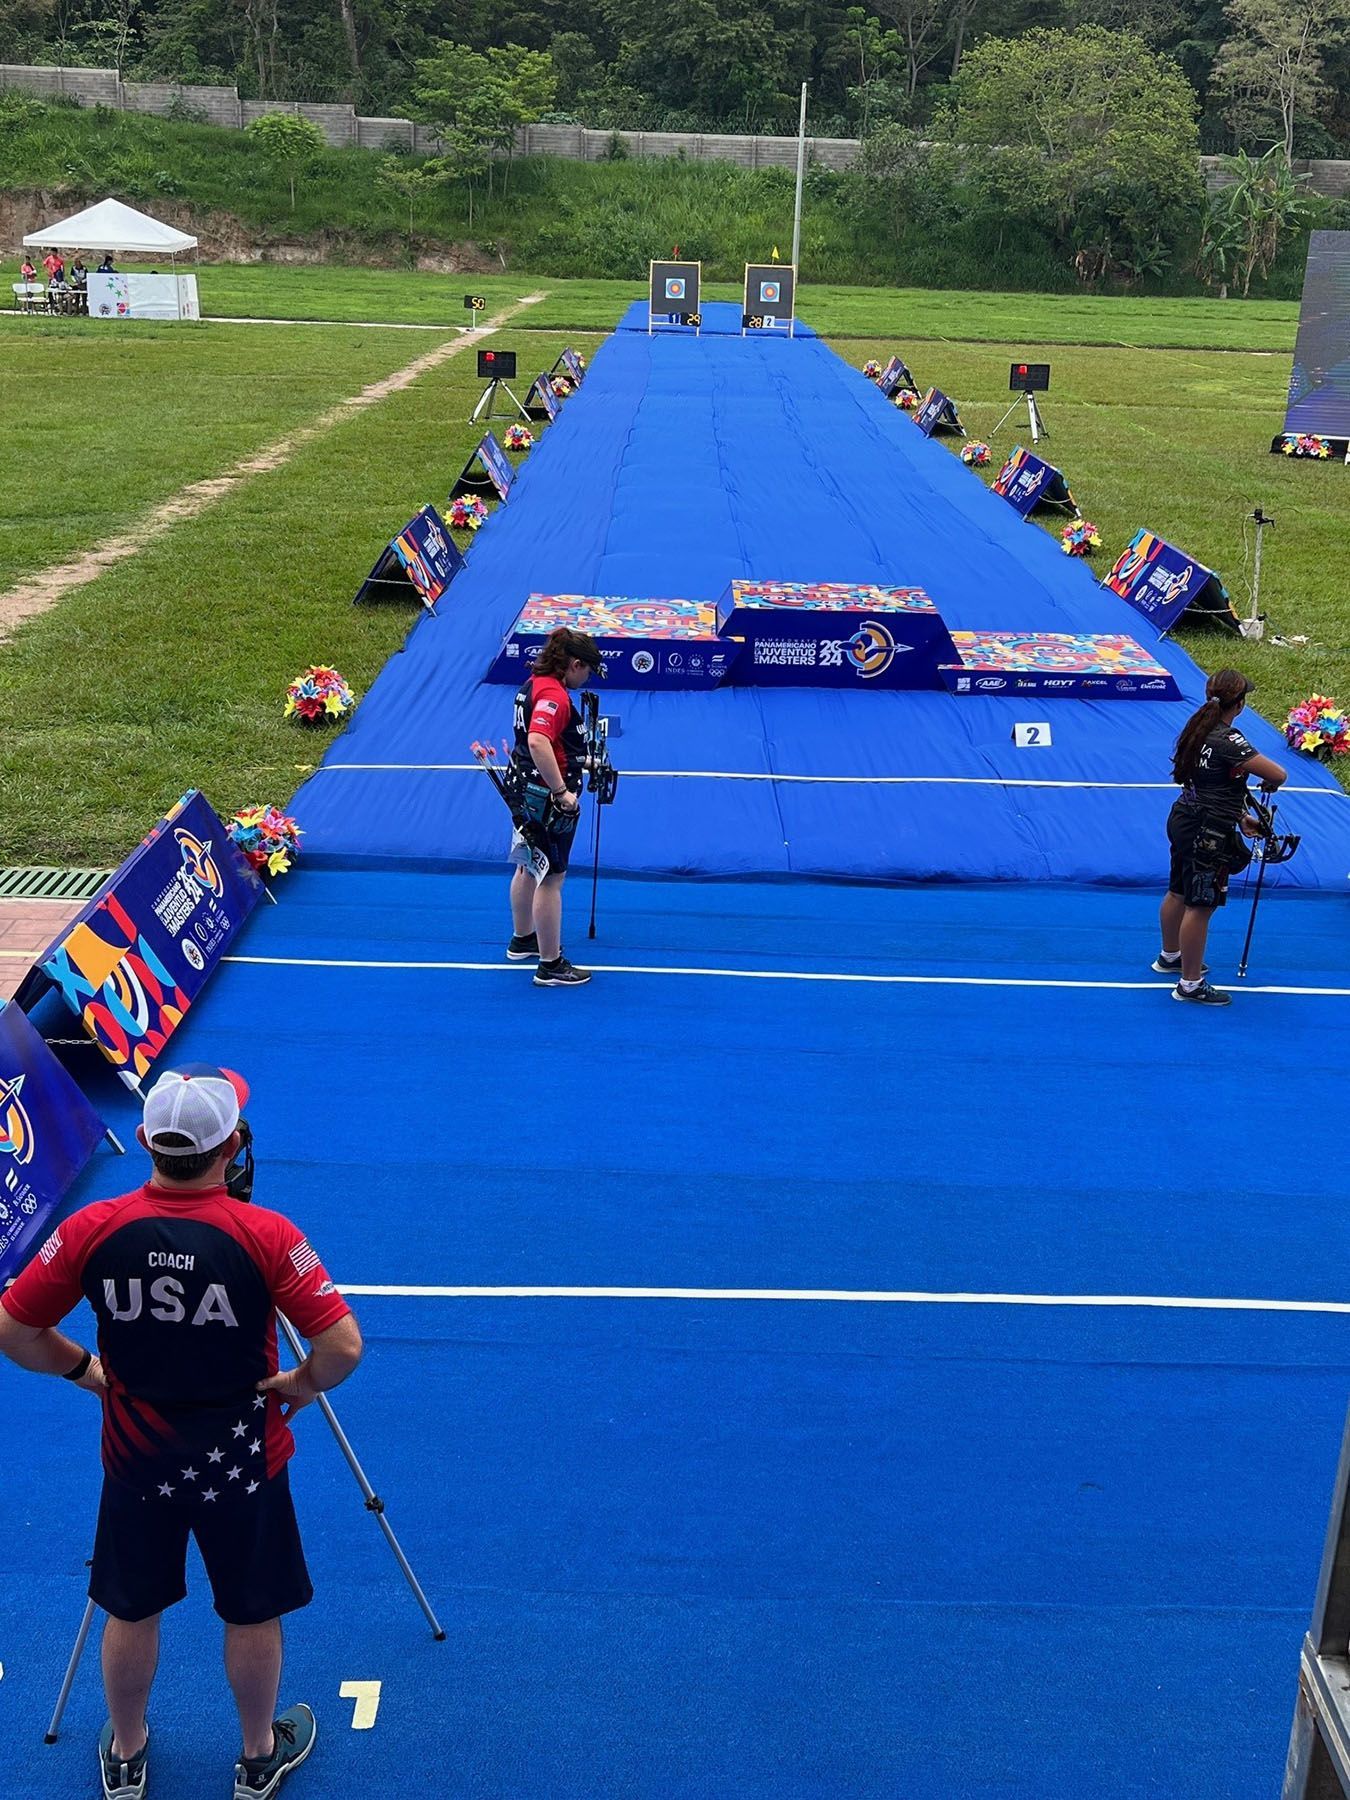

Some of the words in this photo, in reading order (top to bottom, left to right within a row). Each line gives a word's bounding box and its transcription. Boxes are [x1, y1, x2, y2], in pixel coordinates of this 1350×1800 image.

[471, 297, 485, 309] 50
[687, 313, 699, 324] 29
[749, 316, 762, 328] 28
[766, 317, 772, 327] 2
[754, 641, 817, 649] PANAMERICANO
[762, 648, 816, 656] JUVENTUD
[759, 655, 816, 665] MASTERS
[819, 653, 843, 666] 24
[1026, 726, 1041, 745] 2
[154, 880, 182, 917] PANAMERICANO
[187, 879, 204, 905] 24
[163, 889, 188, 924] JUVENTUD
[169, 898, 196, 935] MASTERS
[148, 1251, 195, 1271] COACH
[102, 1275, 239, 1328] USA
